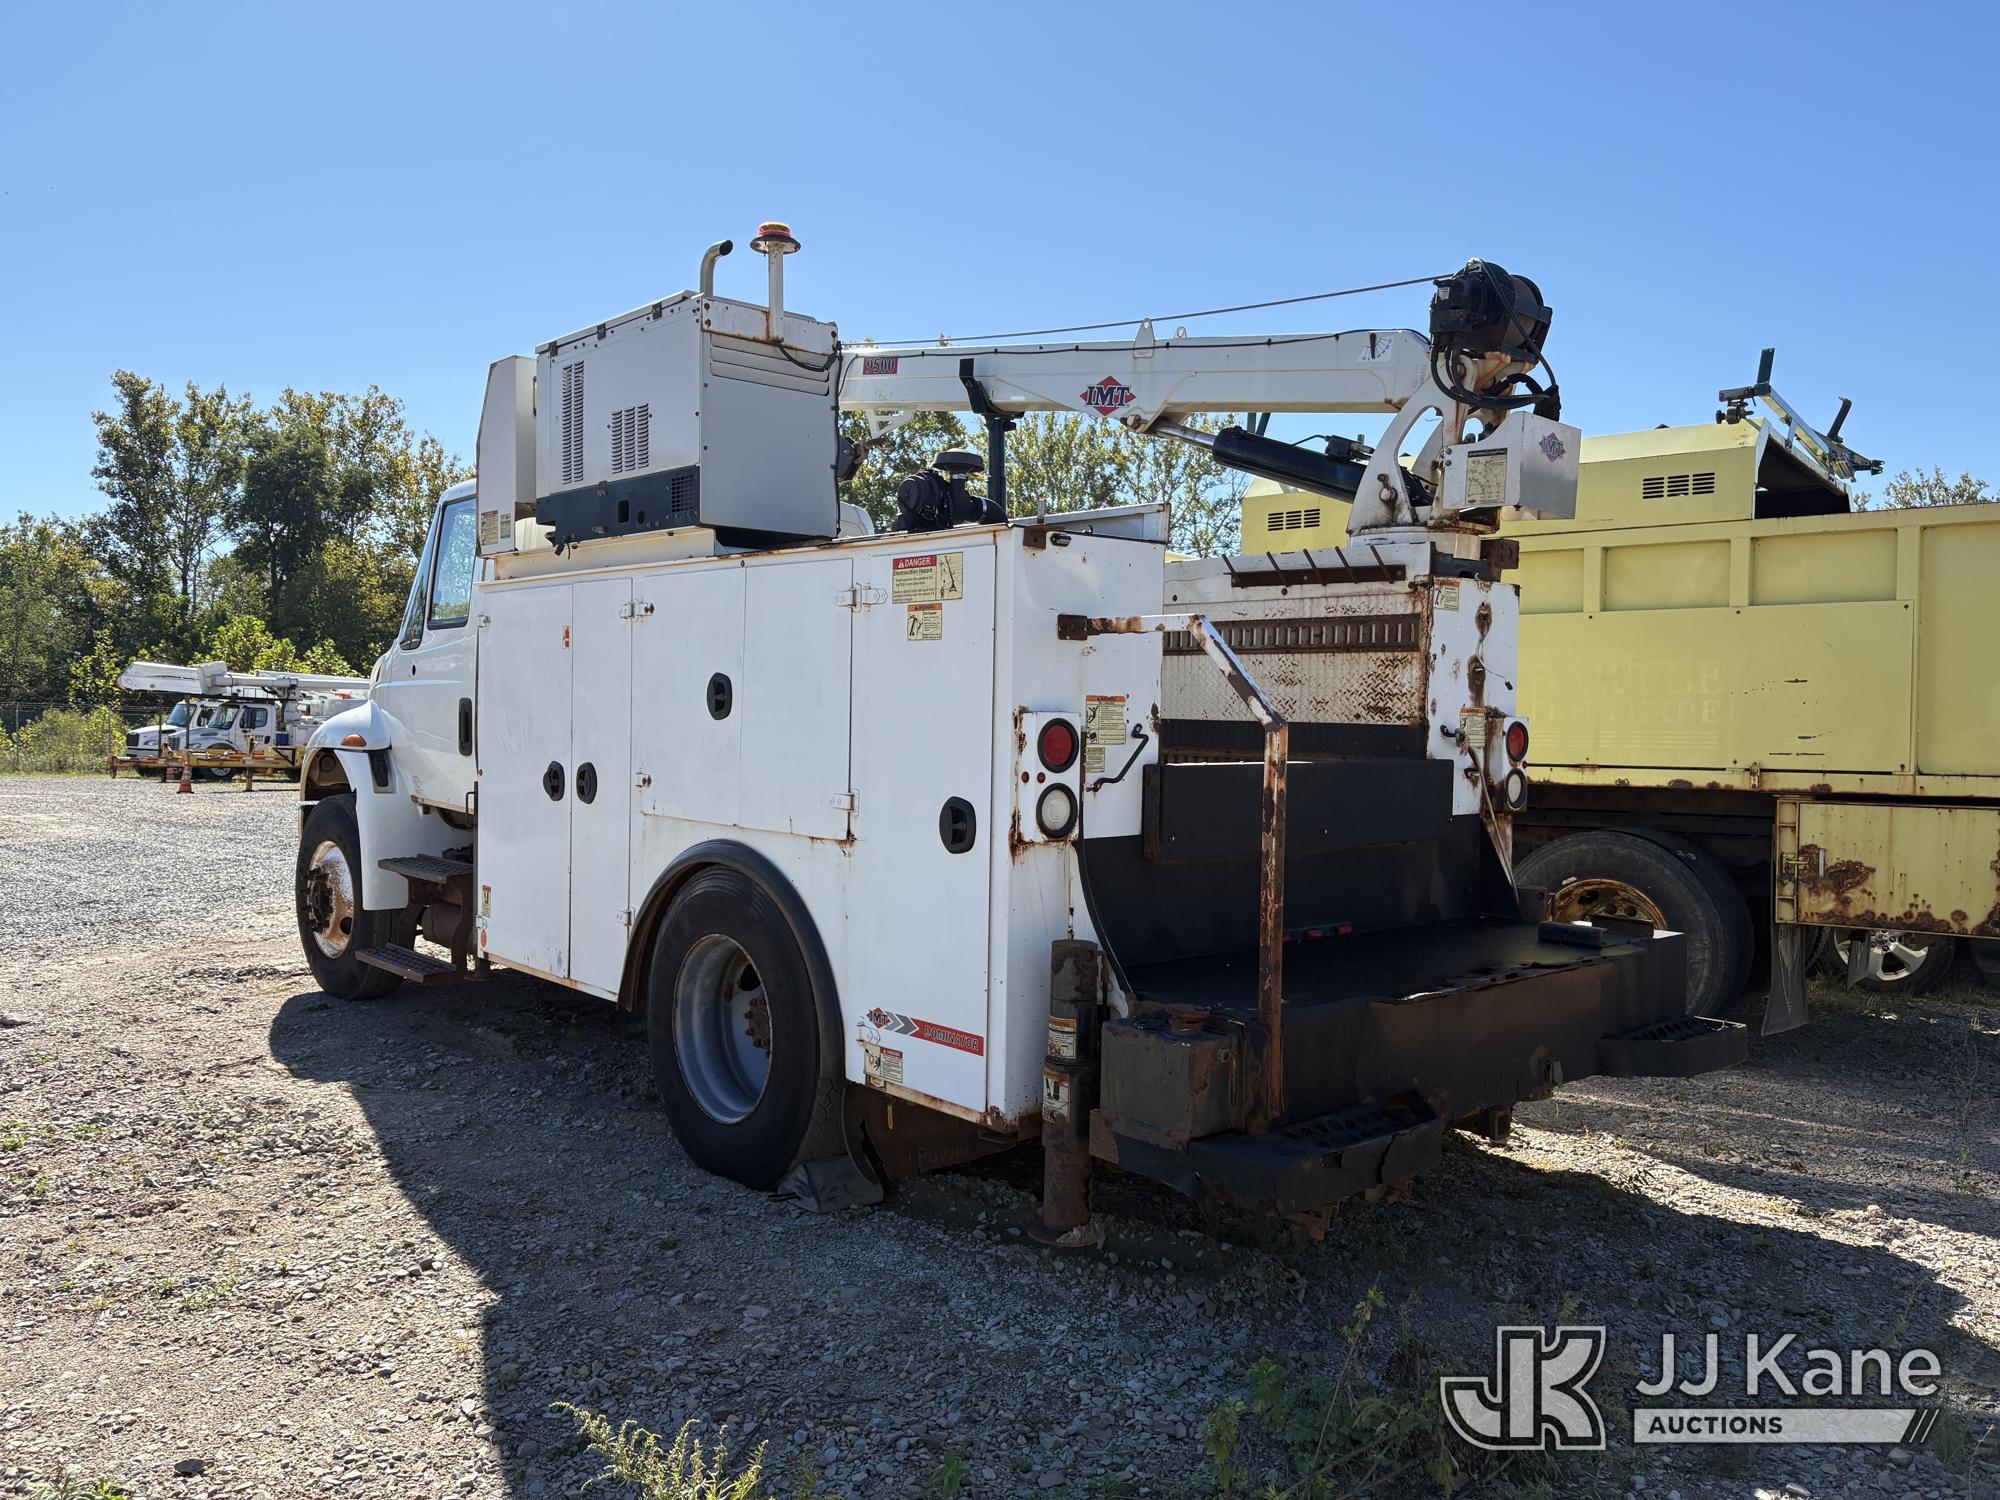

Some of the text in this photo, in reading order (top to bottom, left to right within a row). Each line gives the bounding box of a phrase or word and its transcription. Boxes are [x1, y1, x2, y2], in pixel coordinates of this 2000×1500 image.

[866, 358, 895, 373] 9500
[1086, 386, 1130, 407] IMT
[904, 557, 931, 568] DANGER
[868, 1008, 979, 1051] IMT DOMINATOR
[918, 1143, 970, 1167] Power
